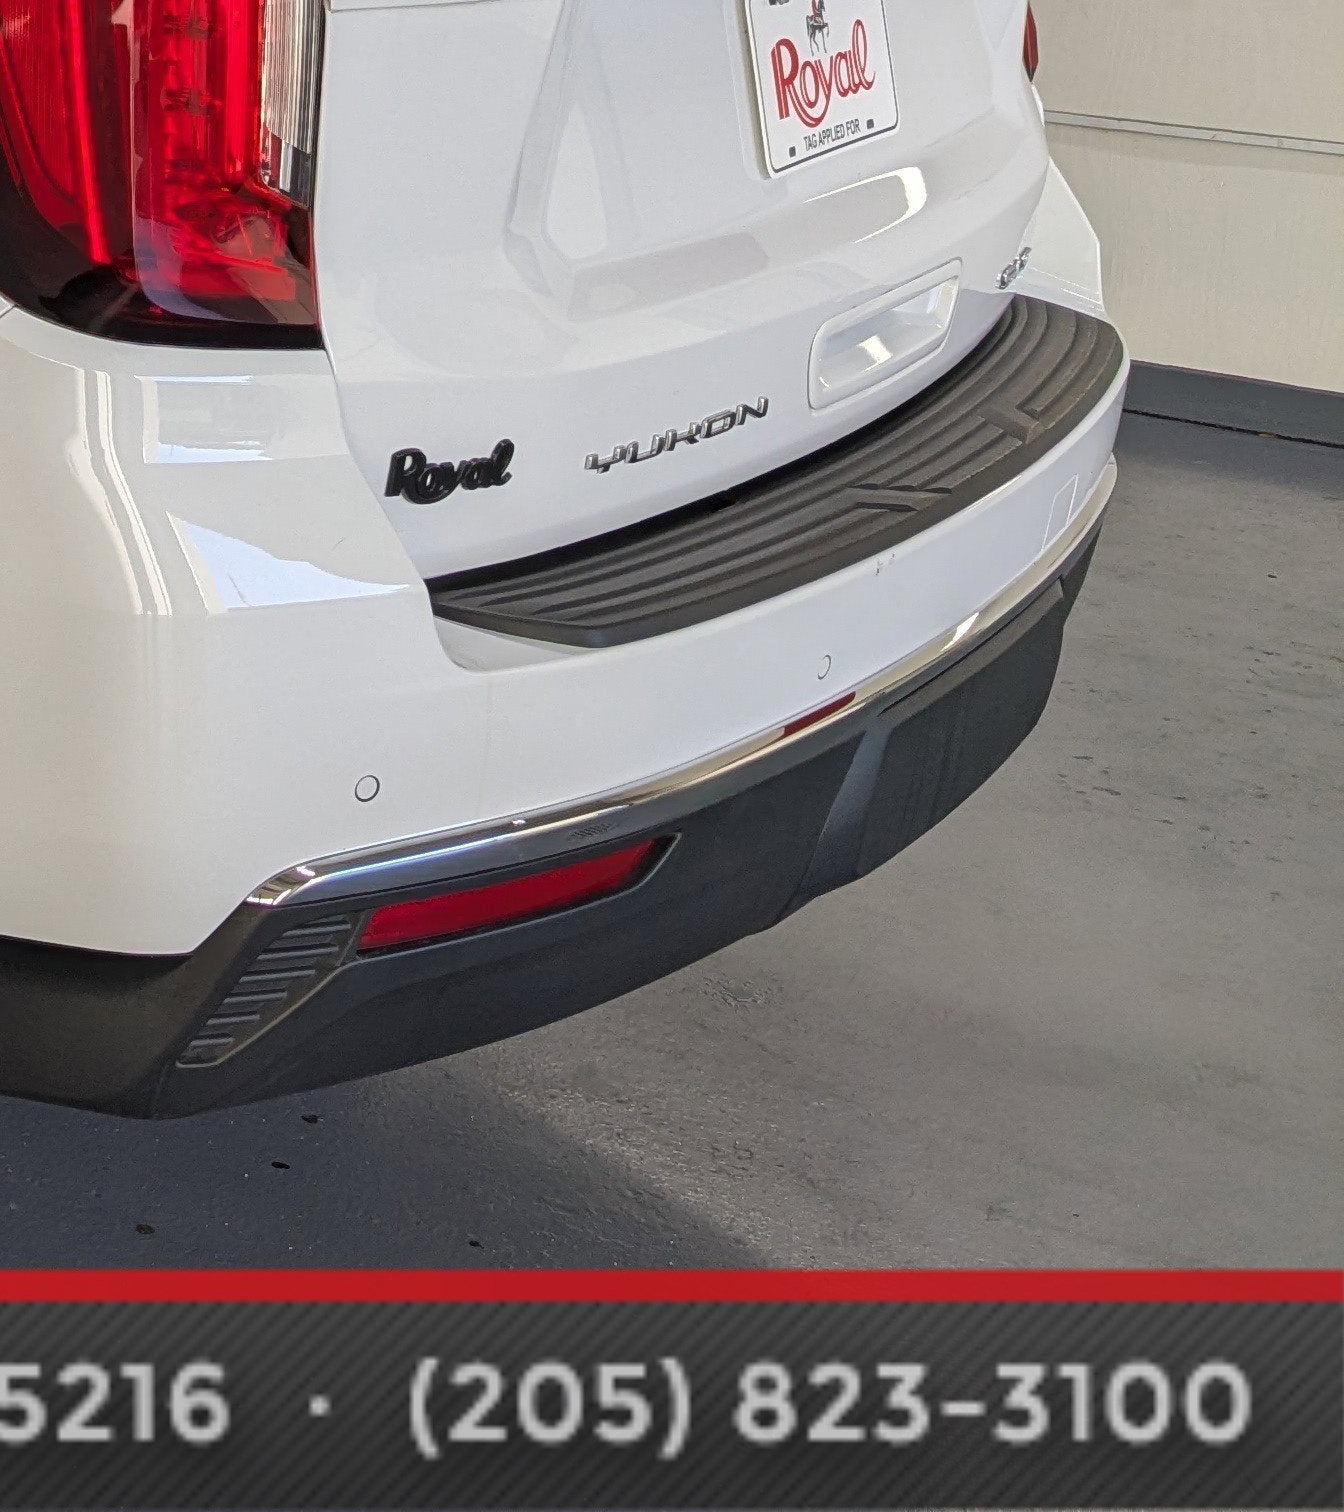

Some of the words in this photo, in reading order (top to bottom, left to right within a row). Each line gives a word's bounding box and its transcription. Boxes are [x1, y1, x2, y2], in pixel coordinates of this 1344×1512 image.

[770, 18, 877, 129] Royal
[803, 133, 818, 152] TAG
[818, 123, 845, 147] APPLIED
[845, 118, 862, 136] FOR
[383, 438, 515, 505] Royal
[584, 395, 769, 475] YUKON
